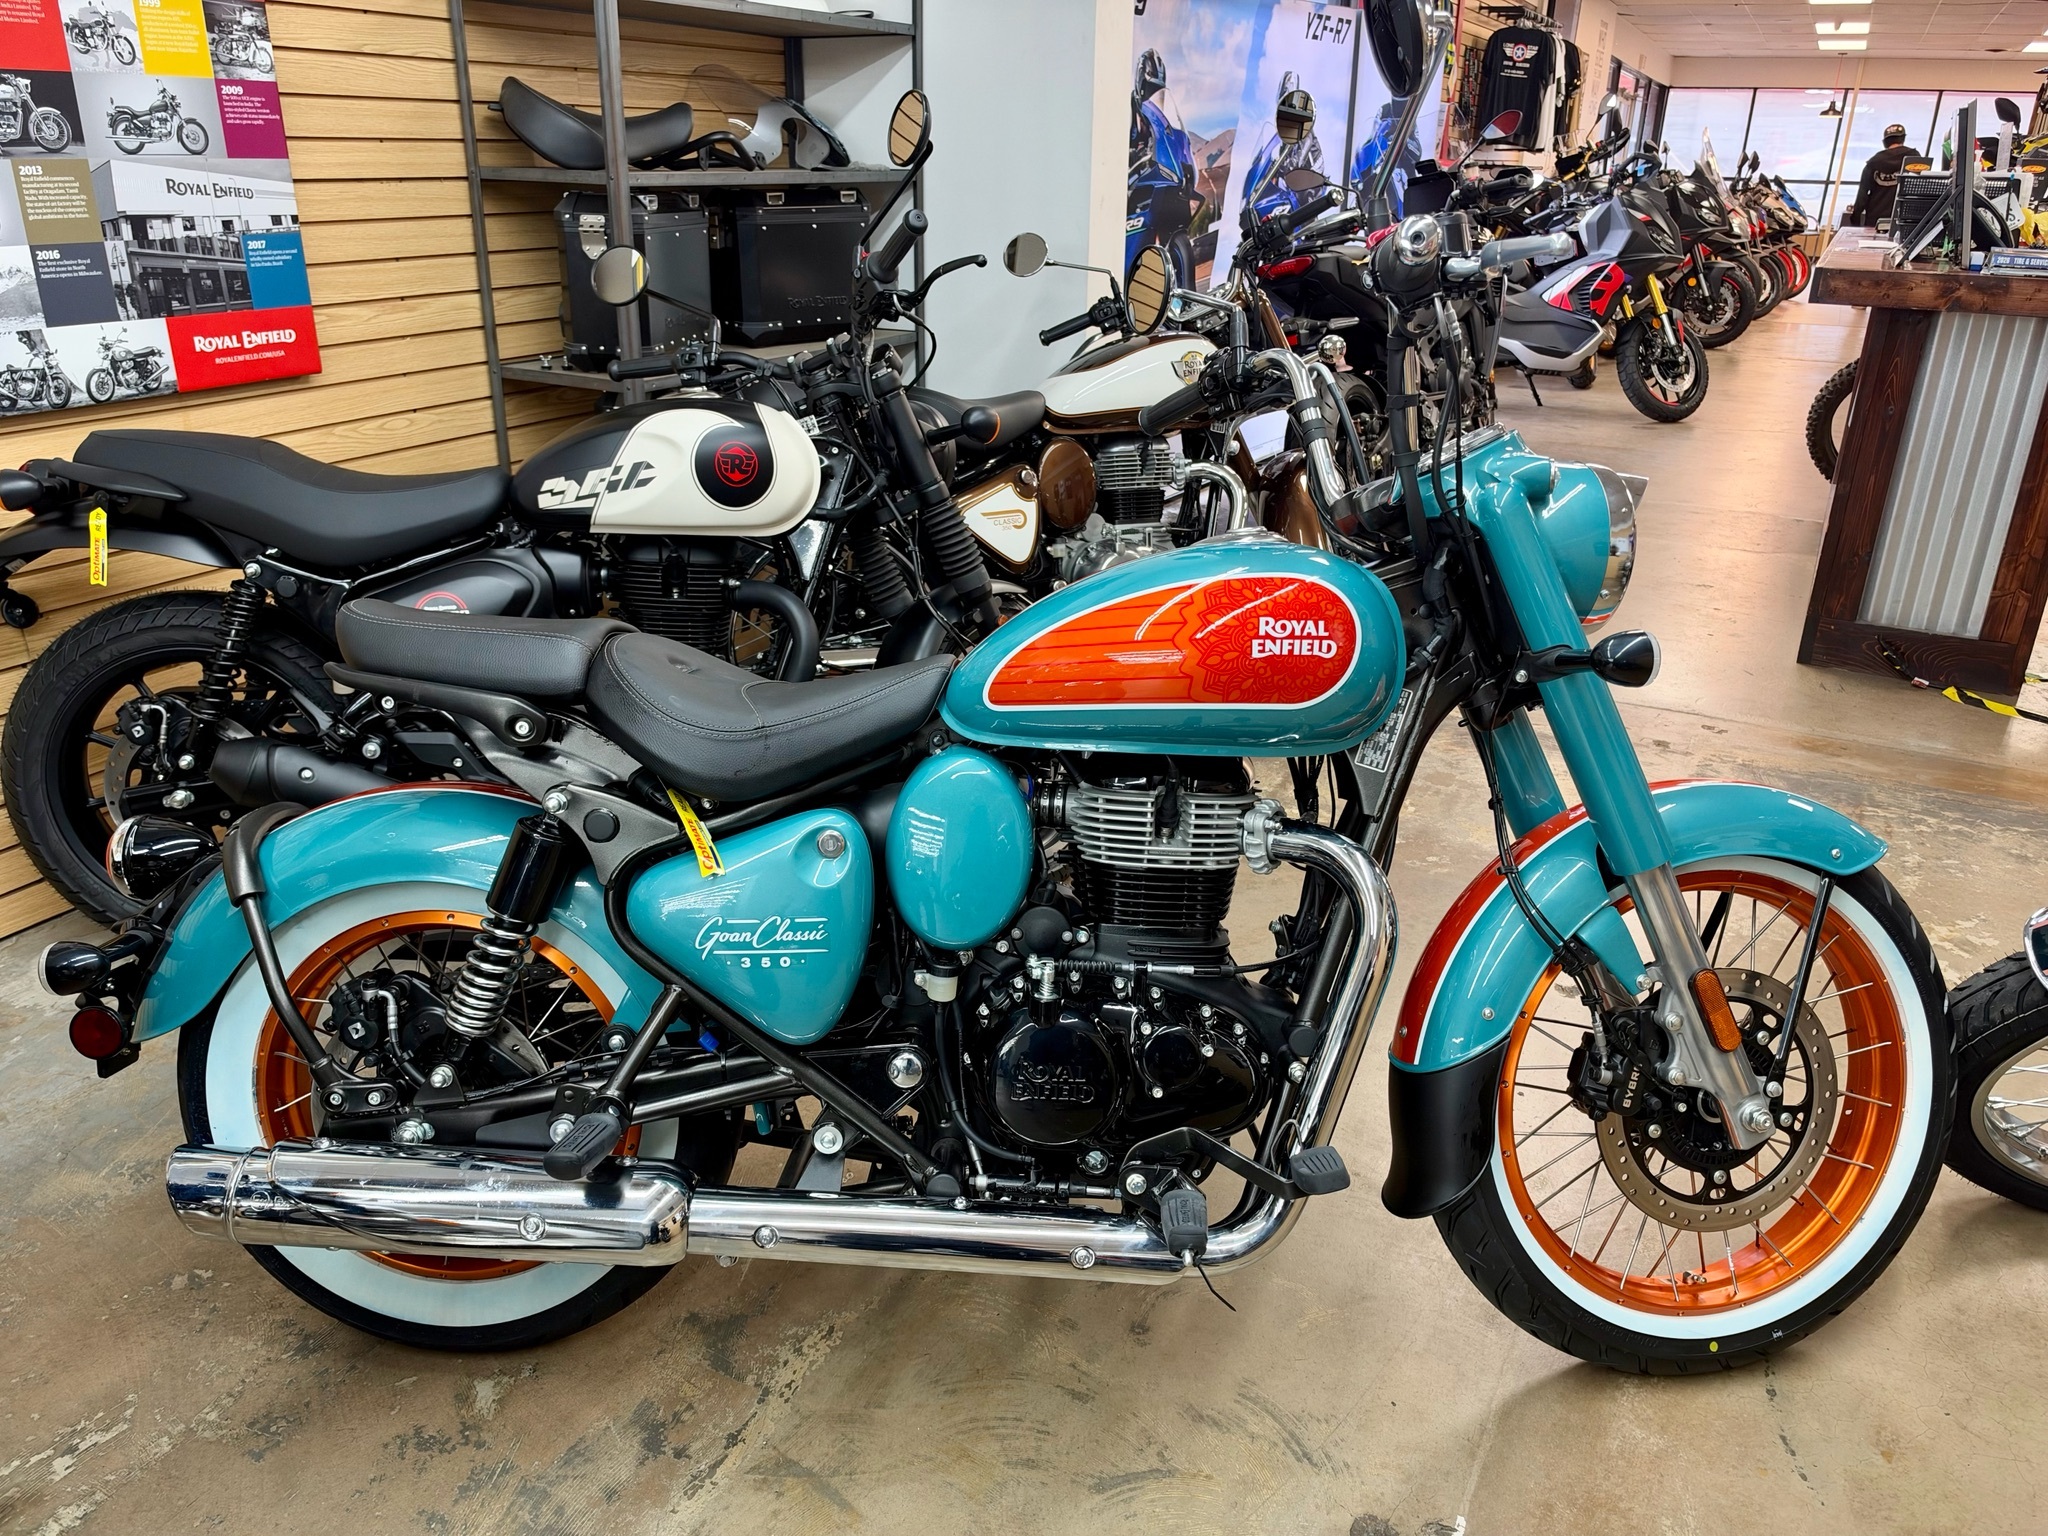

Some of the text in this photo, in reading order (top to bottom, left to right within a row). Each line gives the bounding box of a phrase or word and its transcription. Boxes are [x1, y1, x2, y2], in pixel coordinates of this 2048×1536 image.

[1305, 12, 1352, 44] YZF-R7
[220, 85, 244, 95] 2009
[18, 166, 43, 175] 2013
[165, 178, 254, 199] ROYAL ENFIELD
[246, 240, 266, 249] 2017
[36, 250, 60, 260] 2016
[193, 328, 297, 352] ROYAL ENFIELD
[215, 350, 286, 364] ROYALENFIELD.COM/USA
[1184, 360, 1203, 368] ROYA
[1183, 368, 1201, 377] ENFI
[993, 517, 1022, 526] CLASSIC
[1258, 616, 1329, 638] ROYAL
[1252, 639, 1337, 659] ENFIELD
[695, 915, 828, 961] Goan Classic
[1018, 1057, 1086, 1083] ROYAL
[1010, 1082, 1095, 1104] ENFIELD
